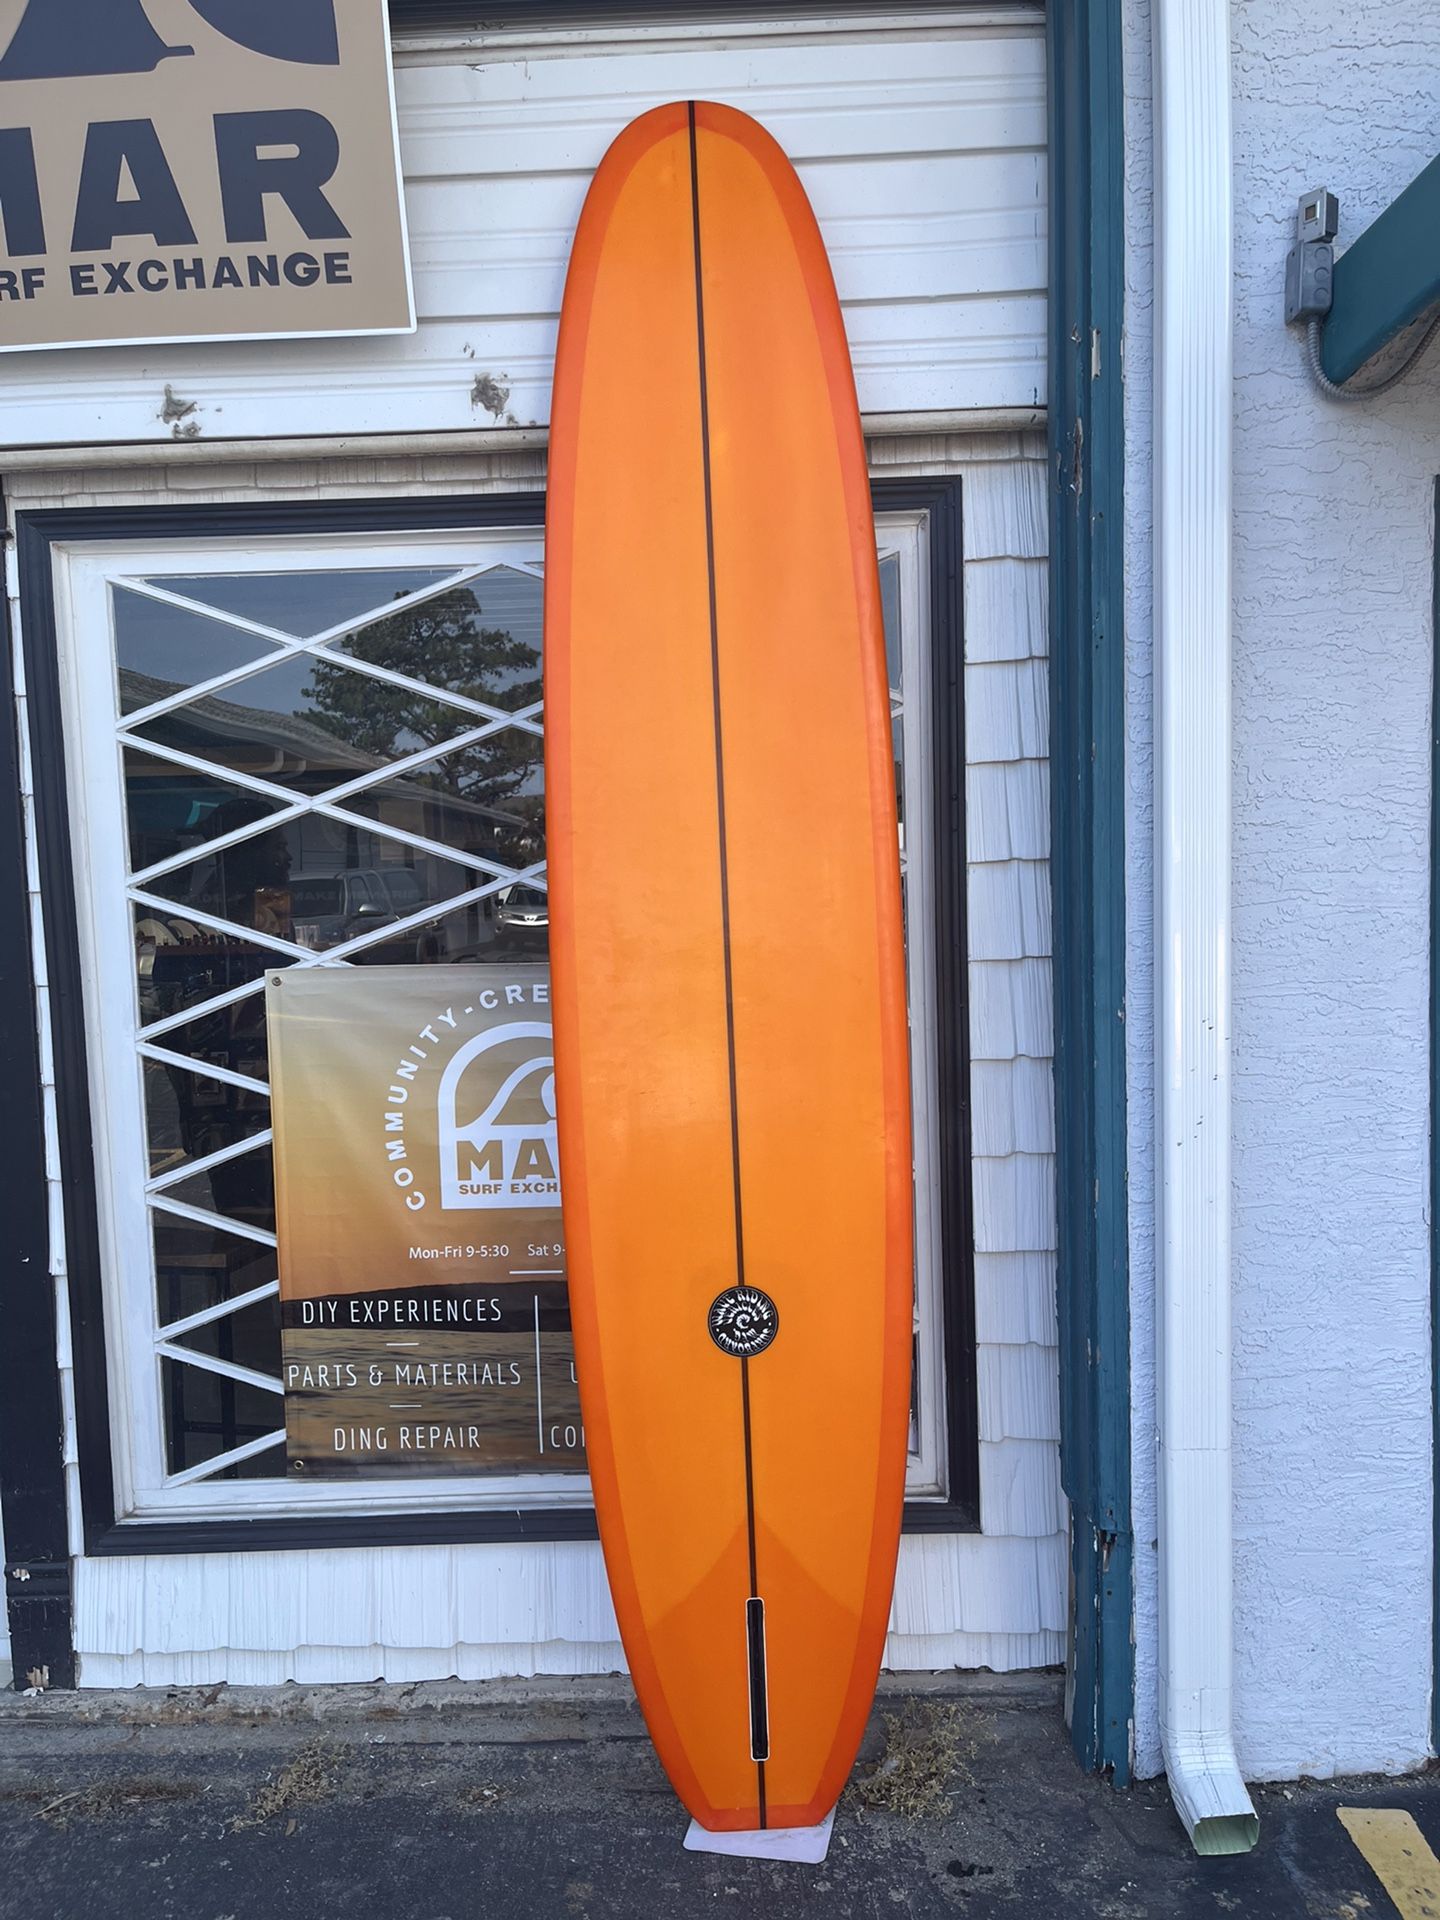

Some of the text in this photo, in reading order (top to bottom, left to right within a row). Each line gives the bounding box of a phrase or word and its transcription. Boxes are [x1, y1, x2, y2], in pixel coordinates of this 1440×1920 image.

[69, 251, 353, 296] EXCHANGE
[458, 1182, 562, 1195] SURF EXCH
[409, 1245, 462, 1259] Mon-Fri
[466, 1244, 509, 1258] 9-5:30
[527, 1243, 549, 1256] Sat
[302, 1298, 502, 1325] DIY EXPERIENCES
[735, 1289, 774, 1320] RIDING
[288, 1362, 521, 1388] PARTS & MATERIALS
[334, 1425, 480, 1451] DING REPAIR
[550, 1425, 586, 1448] CO
